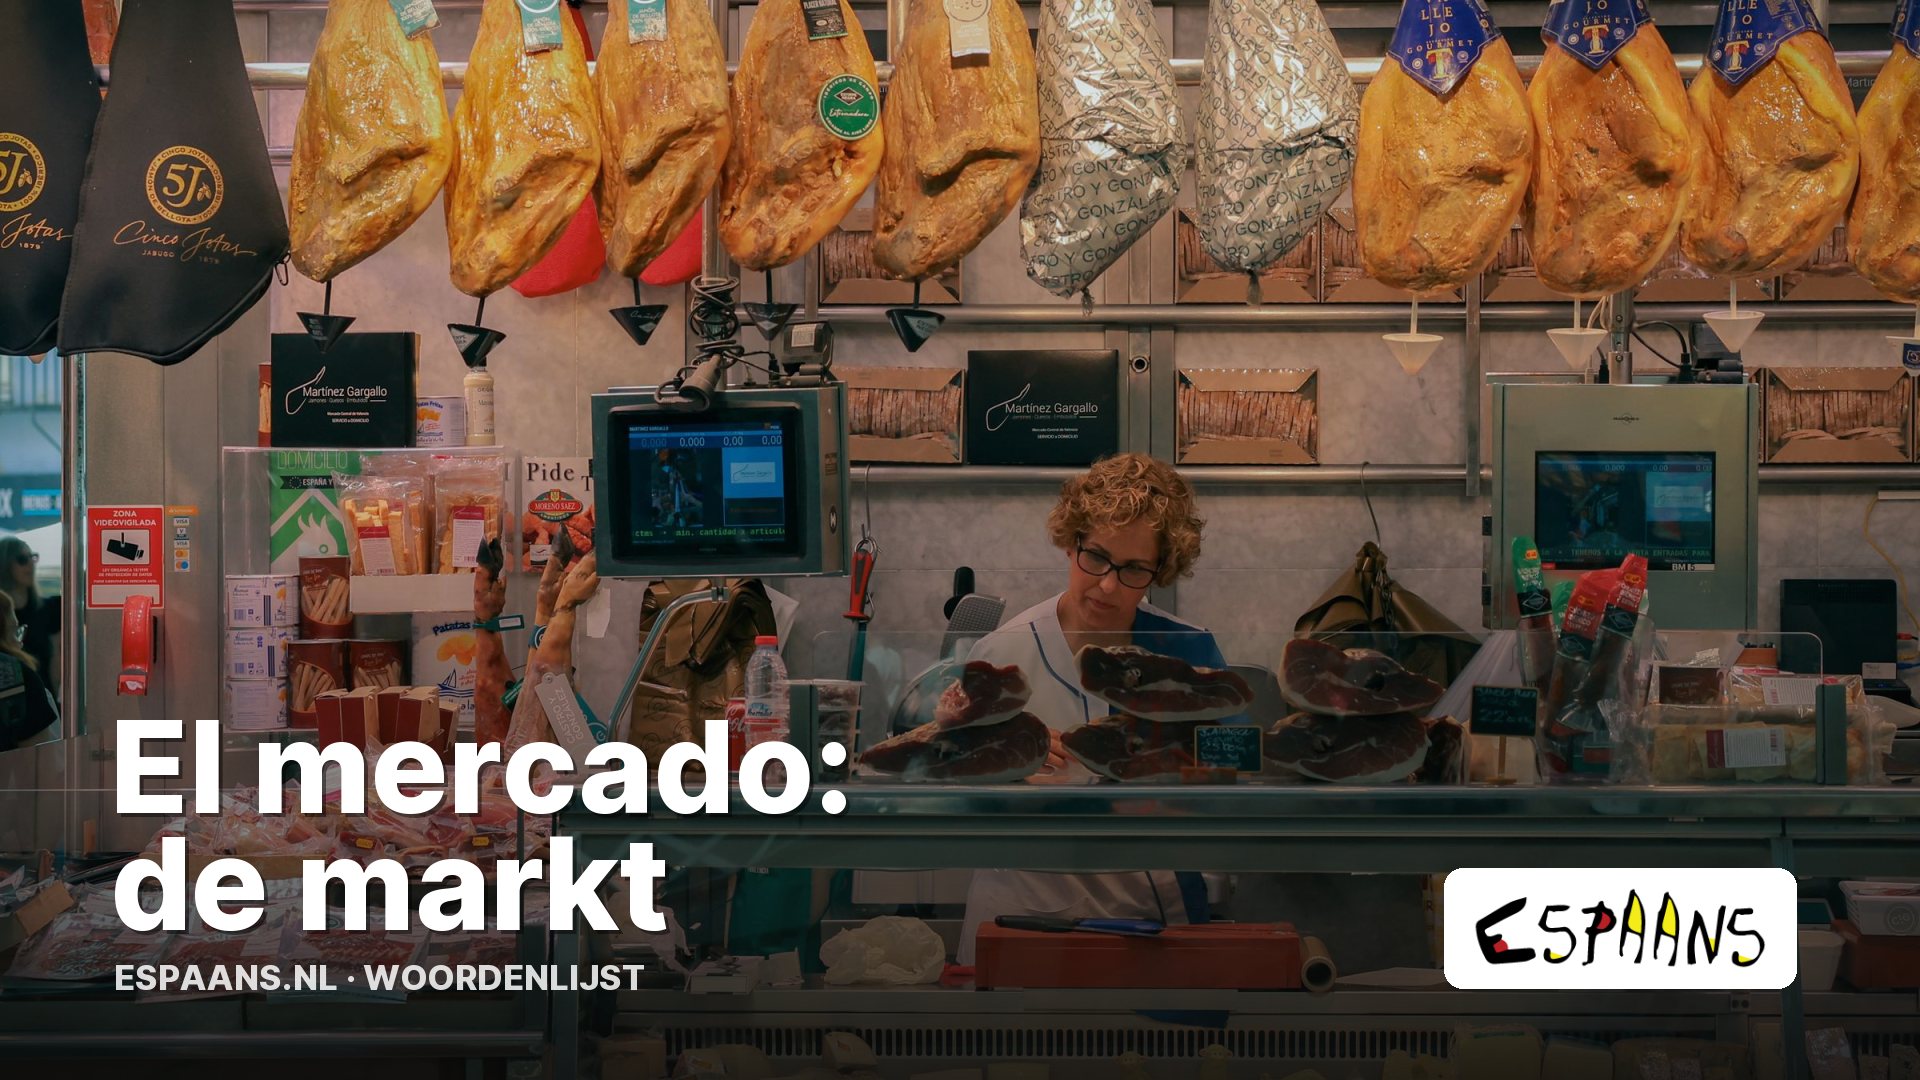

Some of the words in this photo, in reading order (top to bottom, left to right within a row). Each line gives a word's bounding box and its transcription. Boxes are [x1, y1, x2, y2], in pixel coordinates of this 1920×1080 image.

[1563, 17, 1630, 30] GOURMET
[1406, 40, 1473, 54] GOURMET
[161, 147, 186, 159] CINCO
[162, 163, 206, 208] 5J
[114, 220, 179, 245] Cinco
[142, 250, 175, 258] JABUGO
[302, 386, 345, 397] Martínez
[346, 385, 388, 399] Gargallo
[1005, 403, 1051, 413] Martínez
[1054, 402, 1098, 415] Gargallo
[277, 451, 348, 470] DOMICILIO
[527, 462, 575, 481] Pide
[302, 478, 325, 486] ESPAÑA
[326, 478, 333, 486] Y
[535, 502, 560, 510] MORENO
[94, 519, 156, 527] VIDEOVIGILADA
[1672, 563, 1686, 571] BM
[432, 621, 471, 636] Patatas
[552, 705, 577, 745] CASTRO
